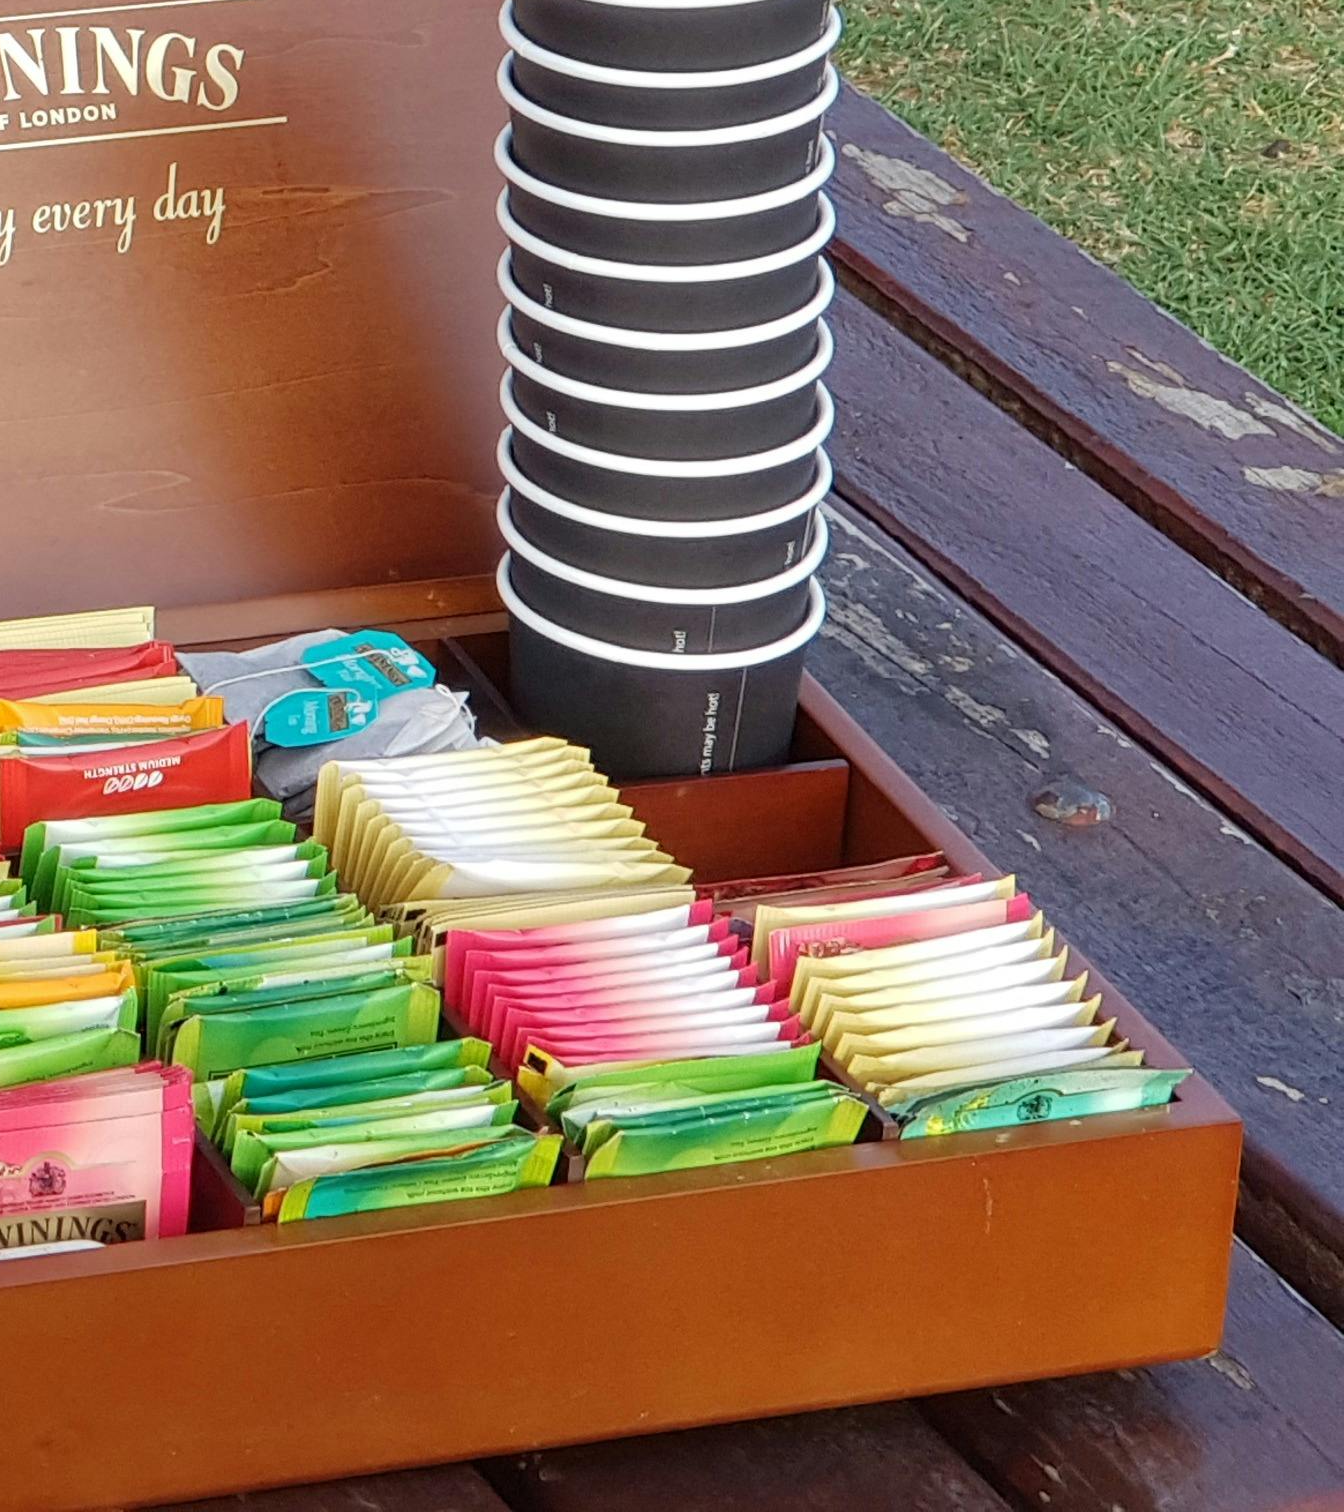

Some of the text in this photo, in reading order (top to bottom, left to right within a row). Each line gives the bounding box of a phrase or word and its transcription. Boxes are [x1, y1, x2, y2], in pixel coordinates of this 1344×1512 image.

[20, 103, 117, 129] LONDON
[32, 196, 136, 254] every
[154, 162, 226, 245] day
[672, 630, 687, 653] hot!
[705, 692, 720, 715] hot!
[703, 718, 716, 732] be
[703, 734, 717, 757] may
[83, 755, 182, 779] MEDIUM STRENGTH
